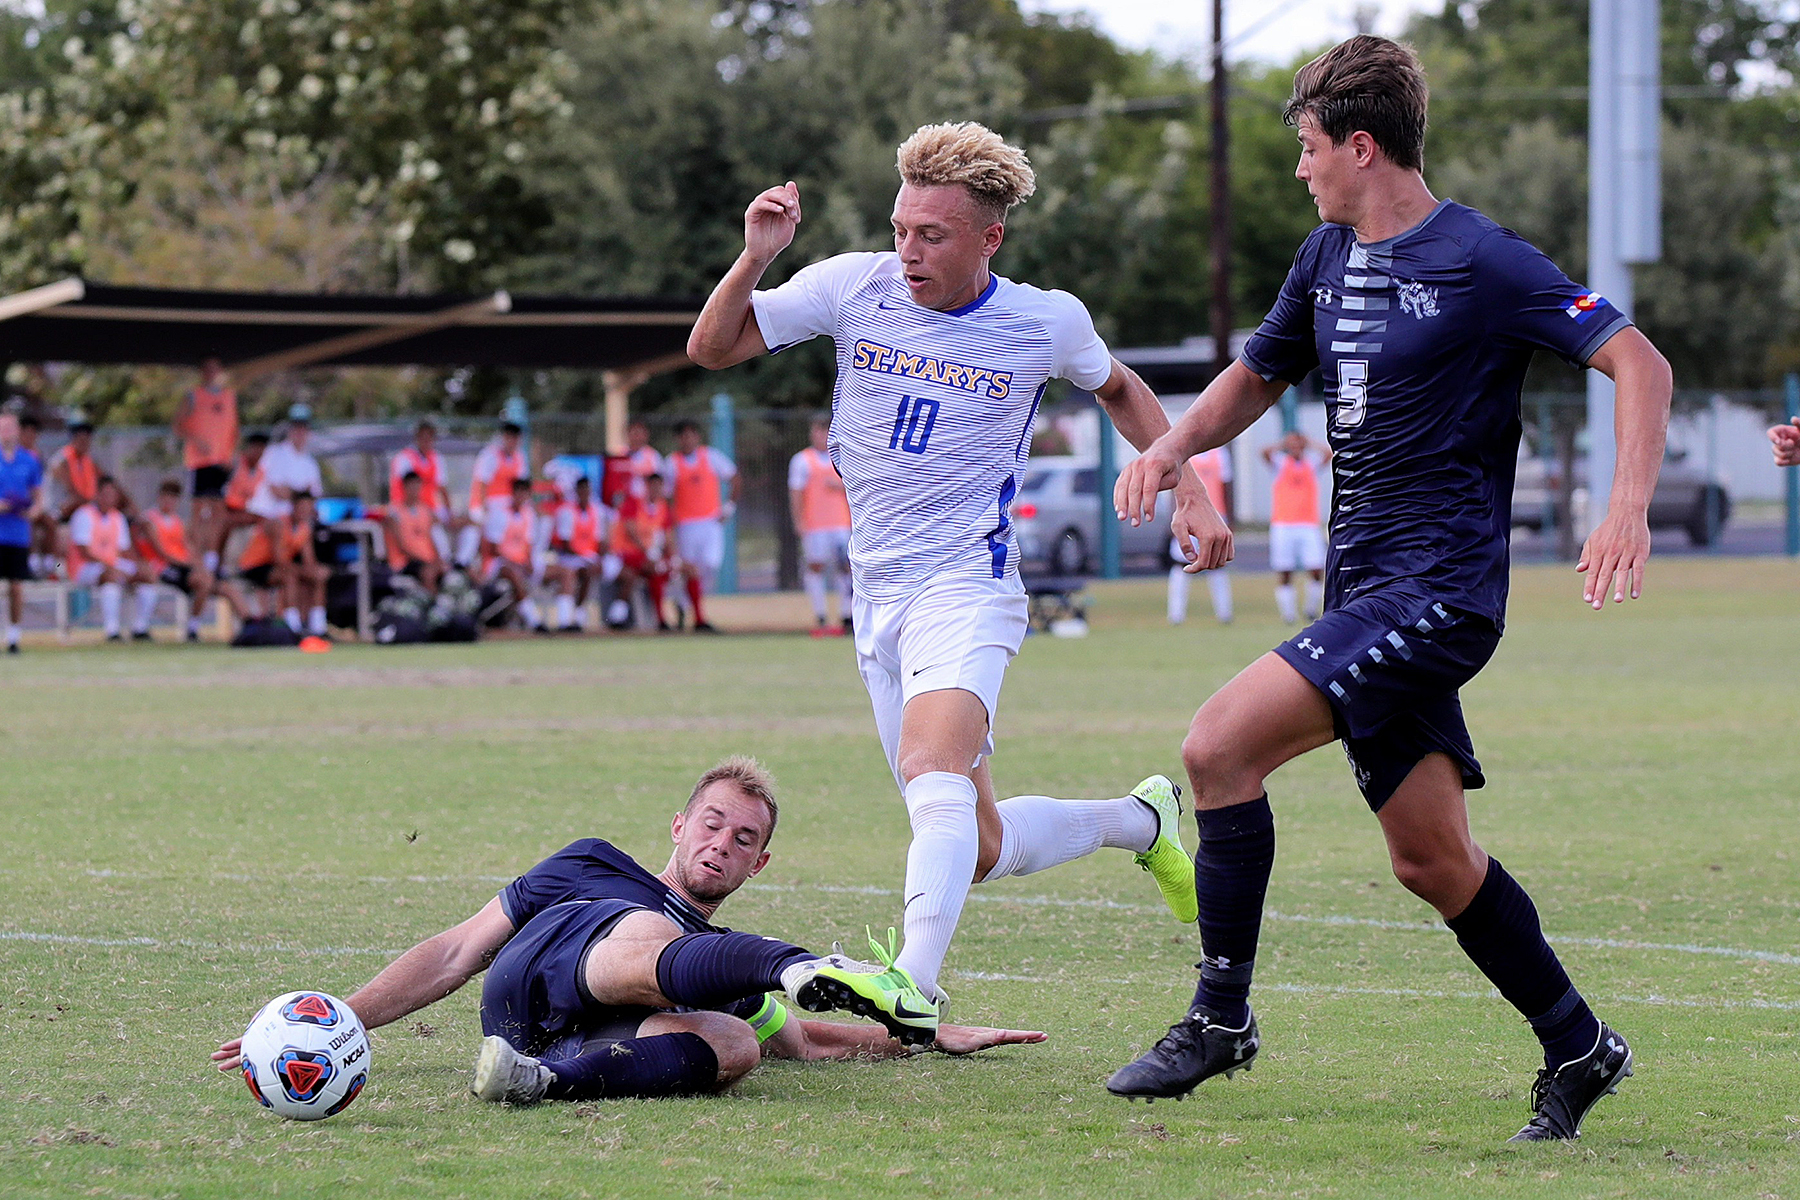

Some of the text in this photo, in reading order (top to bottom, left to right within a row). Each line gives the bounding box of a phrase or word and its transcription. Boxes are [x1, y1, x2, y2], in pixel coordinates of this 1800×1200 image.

[1335, 359, 1369, 428] 5
[888, 394, 940, 455] 10
[328, 1026, 360, 1051] Wilson
